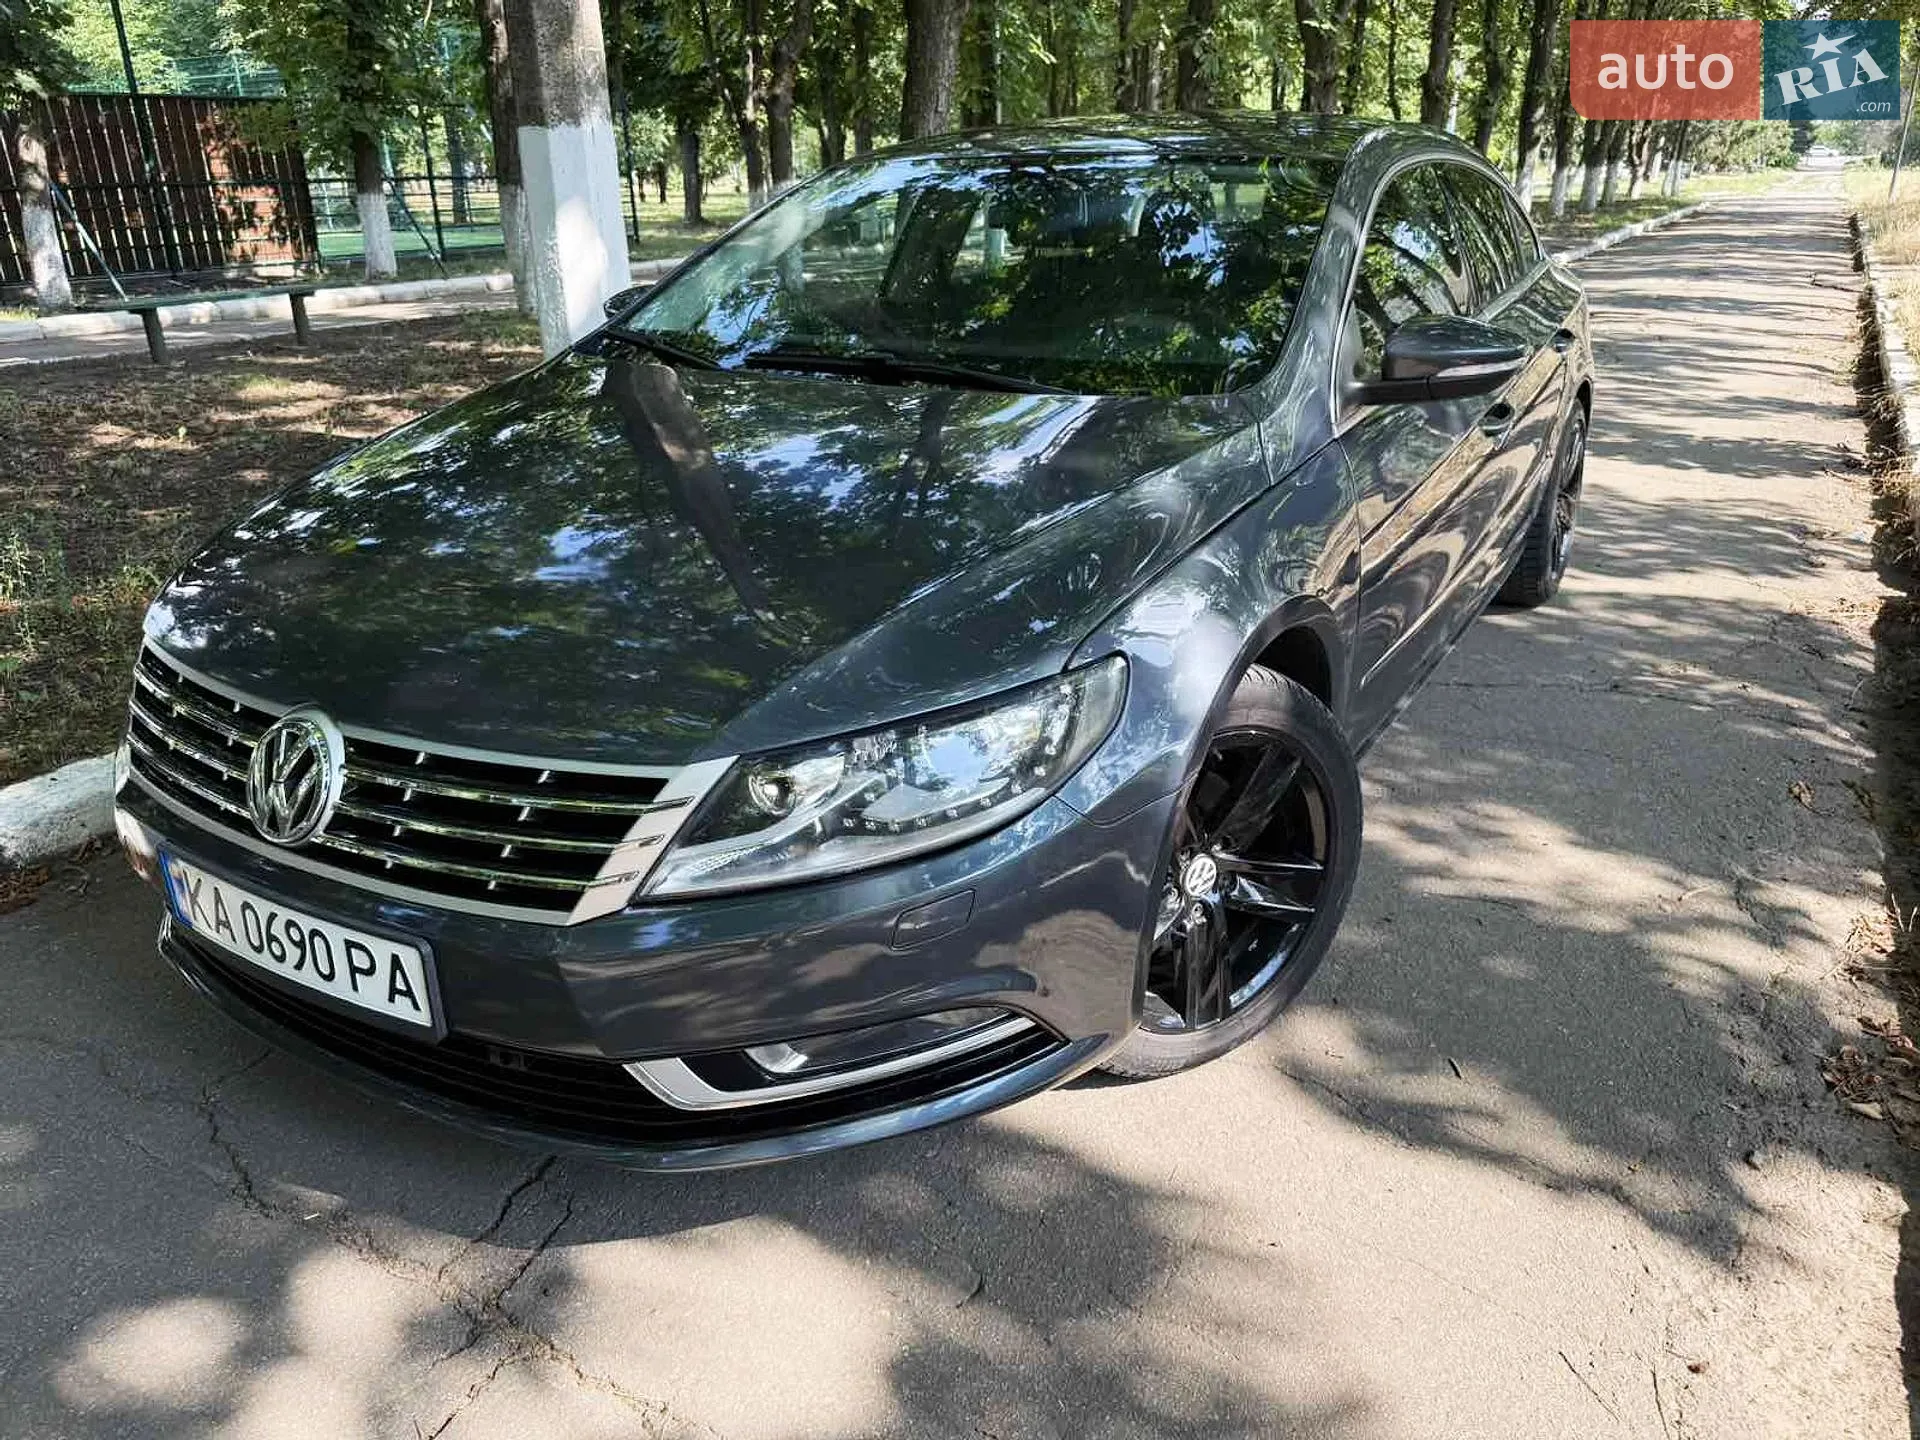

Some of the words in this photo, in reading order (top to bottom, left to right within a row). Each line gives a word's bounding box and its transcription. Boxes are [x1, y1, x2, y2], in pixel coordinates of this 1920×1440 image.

[183, 869, 237, 943] KA
[240, 901, 335, 982] 0690
[344, 938, 422, 1011] PA
